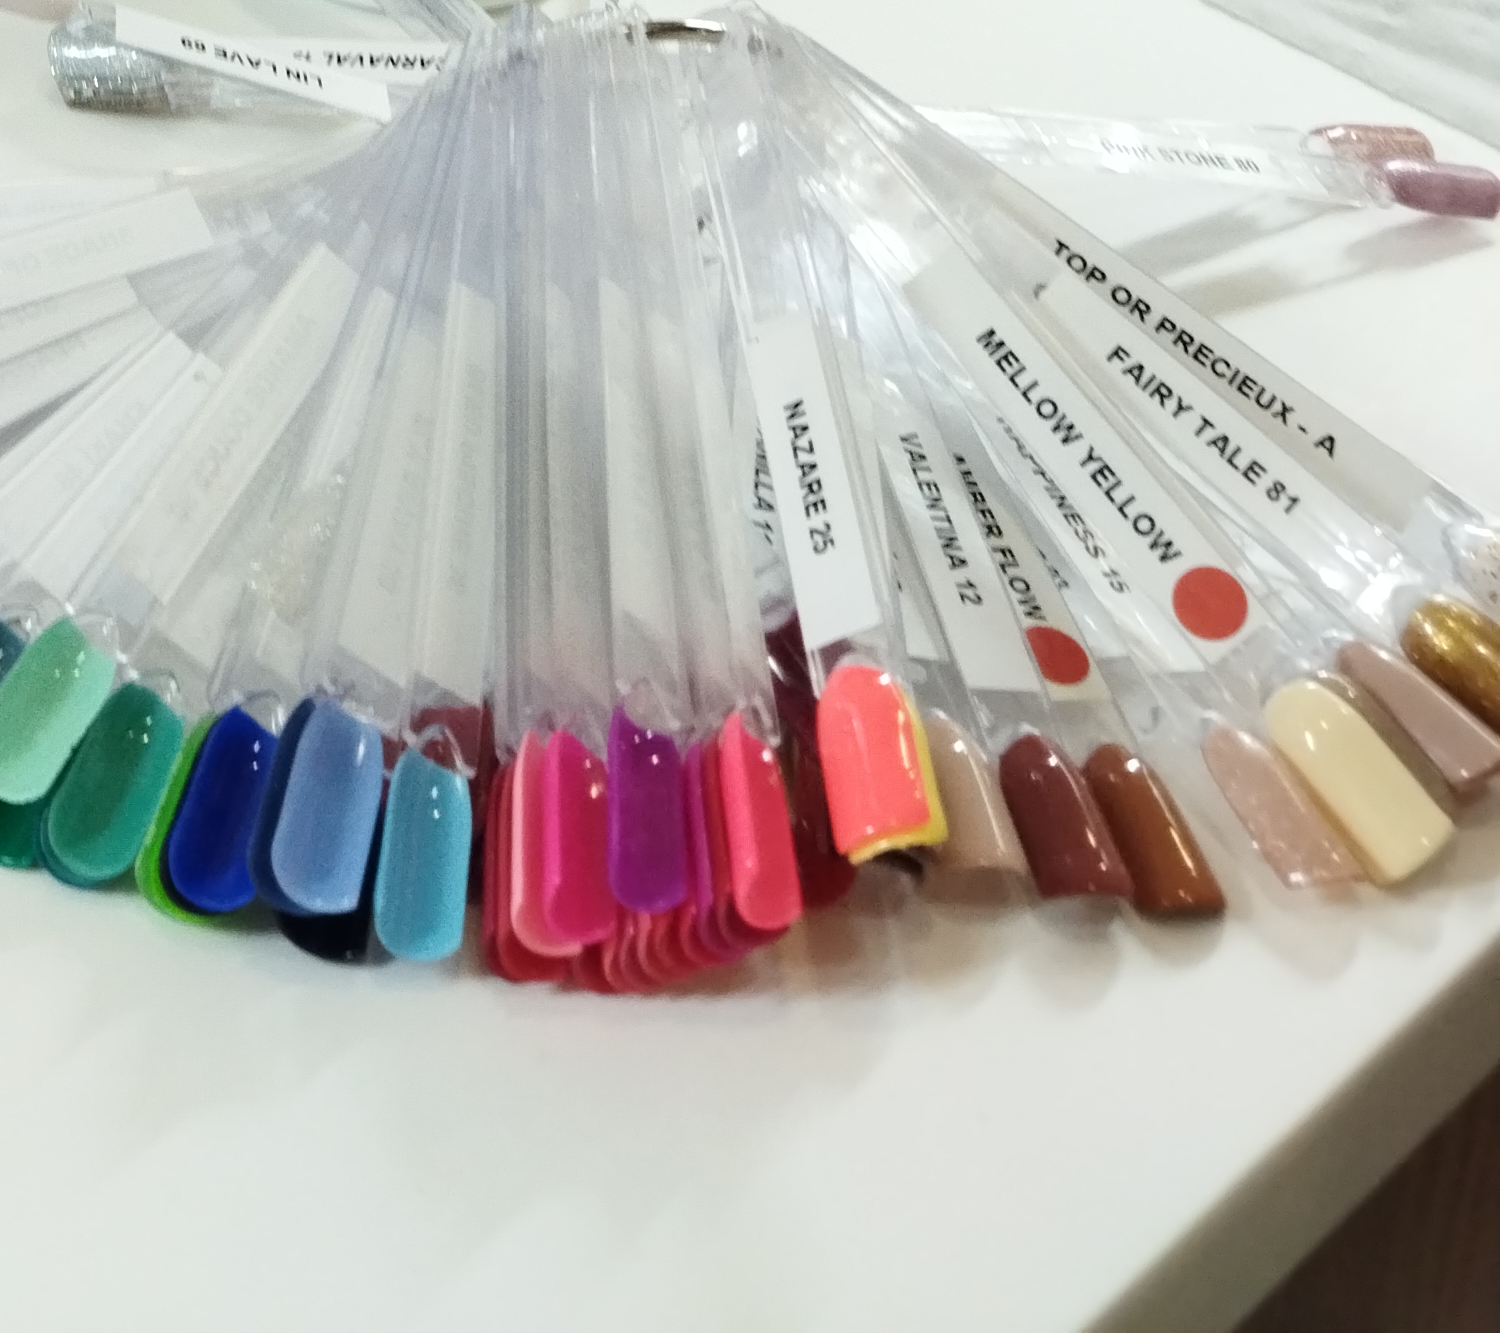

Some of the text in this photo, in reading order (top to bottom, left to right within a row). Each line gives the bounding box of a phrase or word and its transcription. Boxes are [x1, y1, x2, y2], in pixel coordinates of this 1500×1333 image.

[286, 66, 324, 90] LIN
[1158, 144, 1260, 174] STONE 80
[1052, 237, 1108, 288] TOP
[1110, 284, 1152, 325] OR
[1153, 315, 1297, 431] PRECIEUX
[1313, 431, 1339, 461] A
[1105, 344, 1302, 517] FAIRY TALE 81
[783, 397, 836, 557] NAZARE 25
[899, 431, 969, 571] VALENTINA
[954, 576, 983, 606] 12
[975, 326, 1086, 450] MELLOW
[1077, 442, 1184, 567] YELLOW
[992, 544, 1047, 622] FLOW
